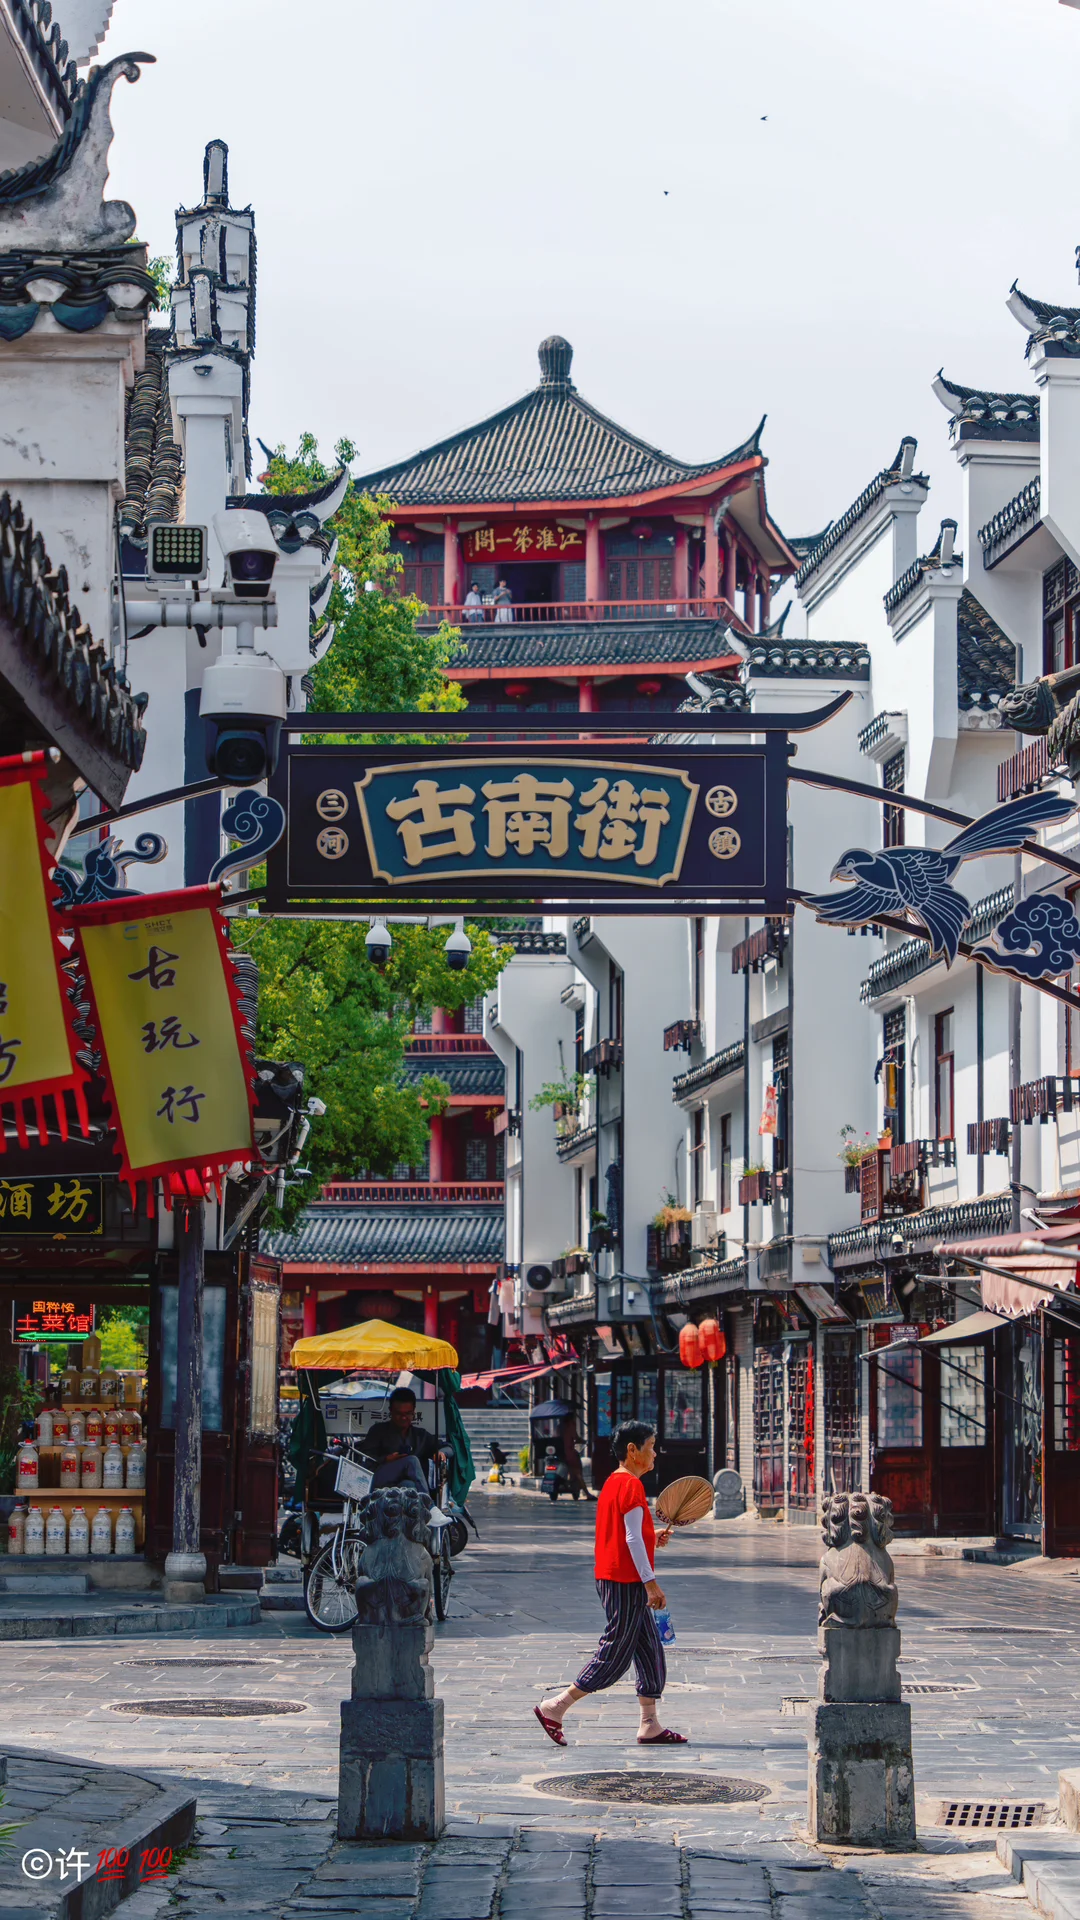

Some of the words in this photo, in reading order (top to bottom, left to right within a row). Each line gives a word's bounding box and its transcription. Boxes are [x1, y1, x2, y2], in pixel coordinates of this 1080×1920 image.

[385, 773, 670, 867] 古南街
[128, 945, 206, 1124] 古玩行
[15, 1314, 91, 1332] 土菜馆
